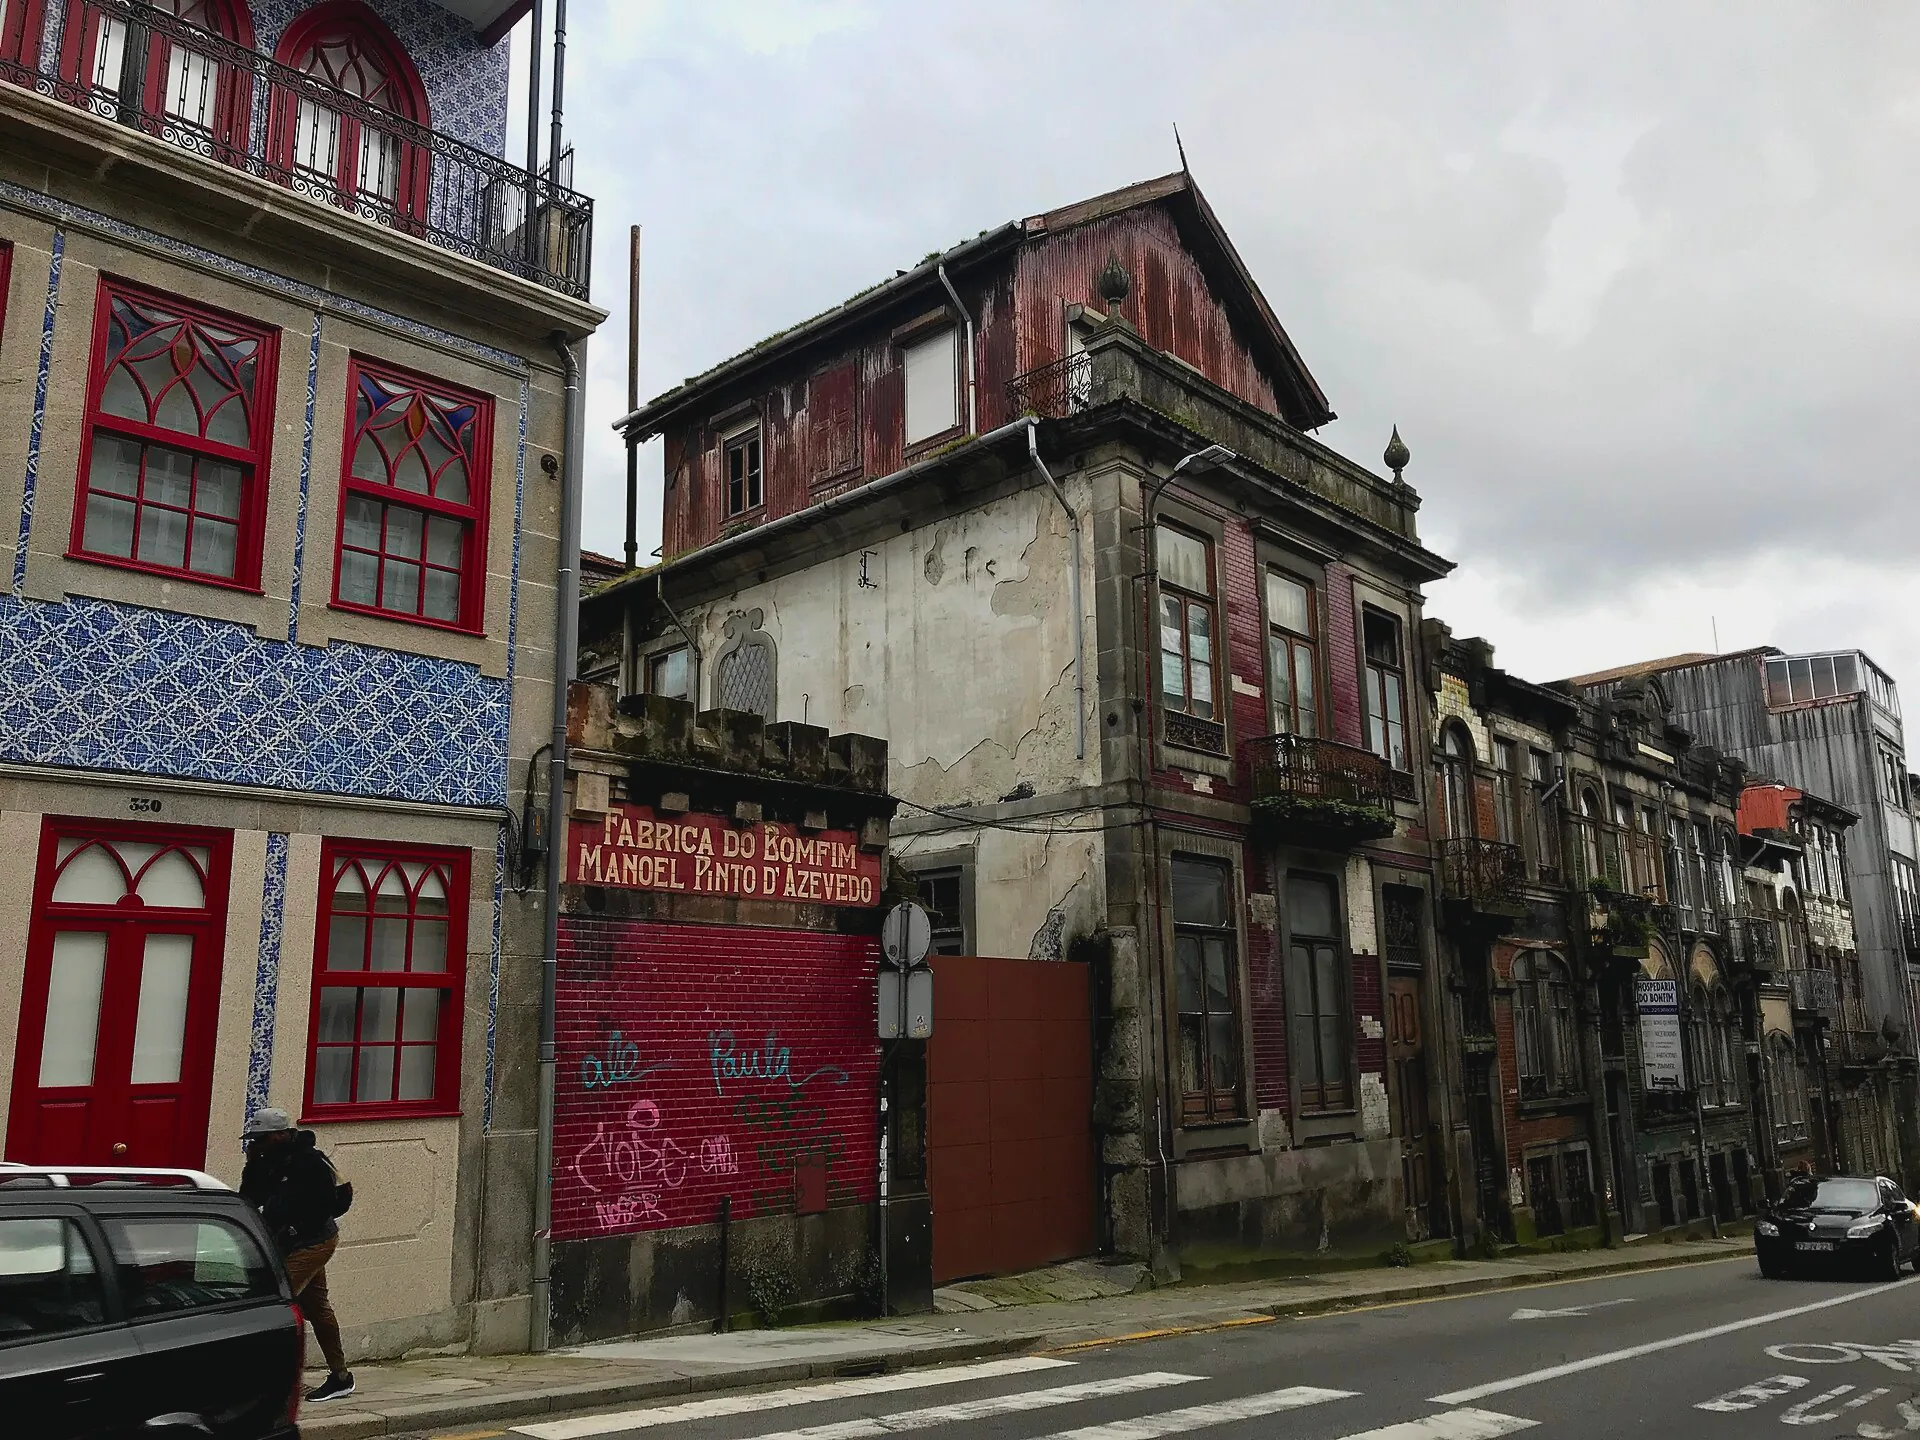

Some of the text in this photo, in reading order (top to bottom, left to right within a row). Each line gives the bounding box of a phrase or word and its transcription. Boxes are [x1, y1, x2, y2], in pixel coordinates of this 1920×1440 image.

[129, 797, 162, 813] 330
[603, 807, 856, 870] FABRICA DO BOMFIM
[577, 843, 872, 903] MANOEL PINTO D'AZEVEDO
[1637, 981, 1675, 992] HOSPEDARIA
[1638, 992, 1674, 1003] DO BONFIM
[708, 1029, 830, 1095] Paula
